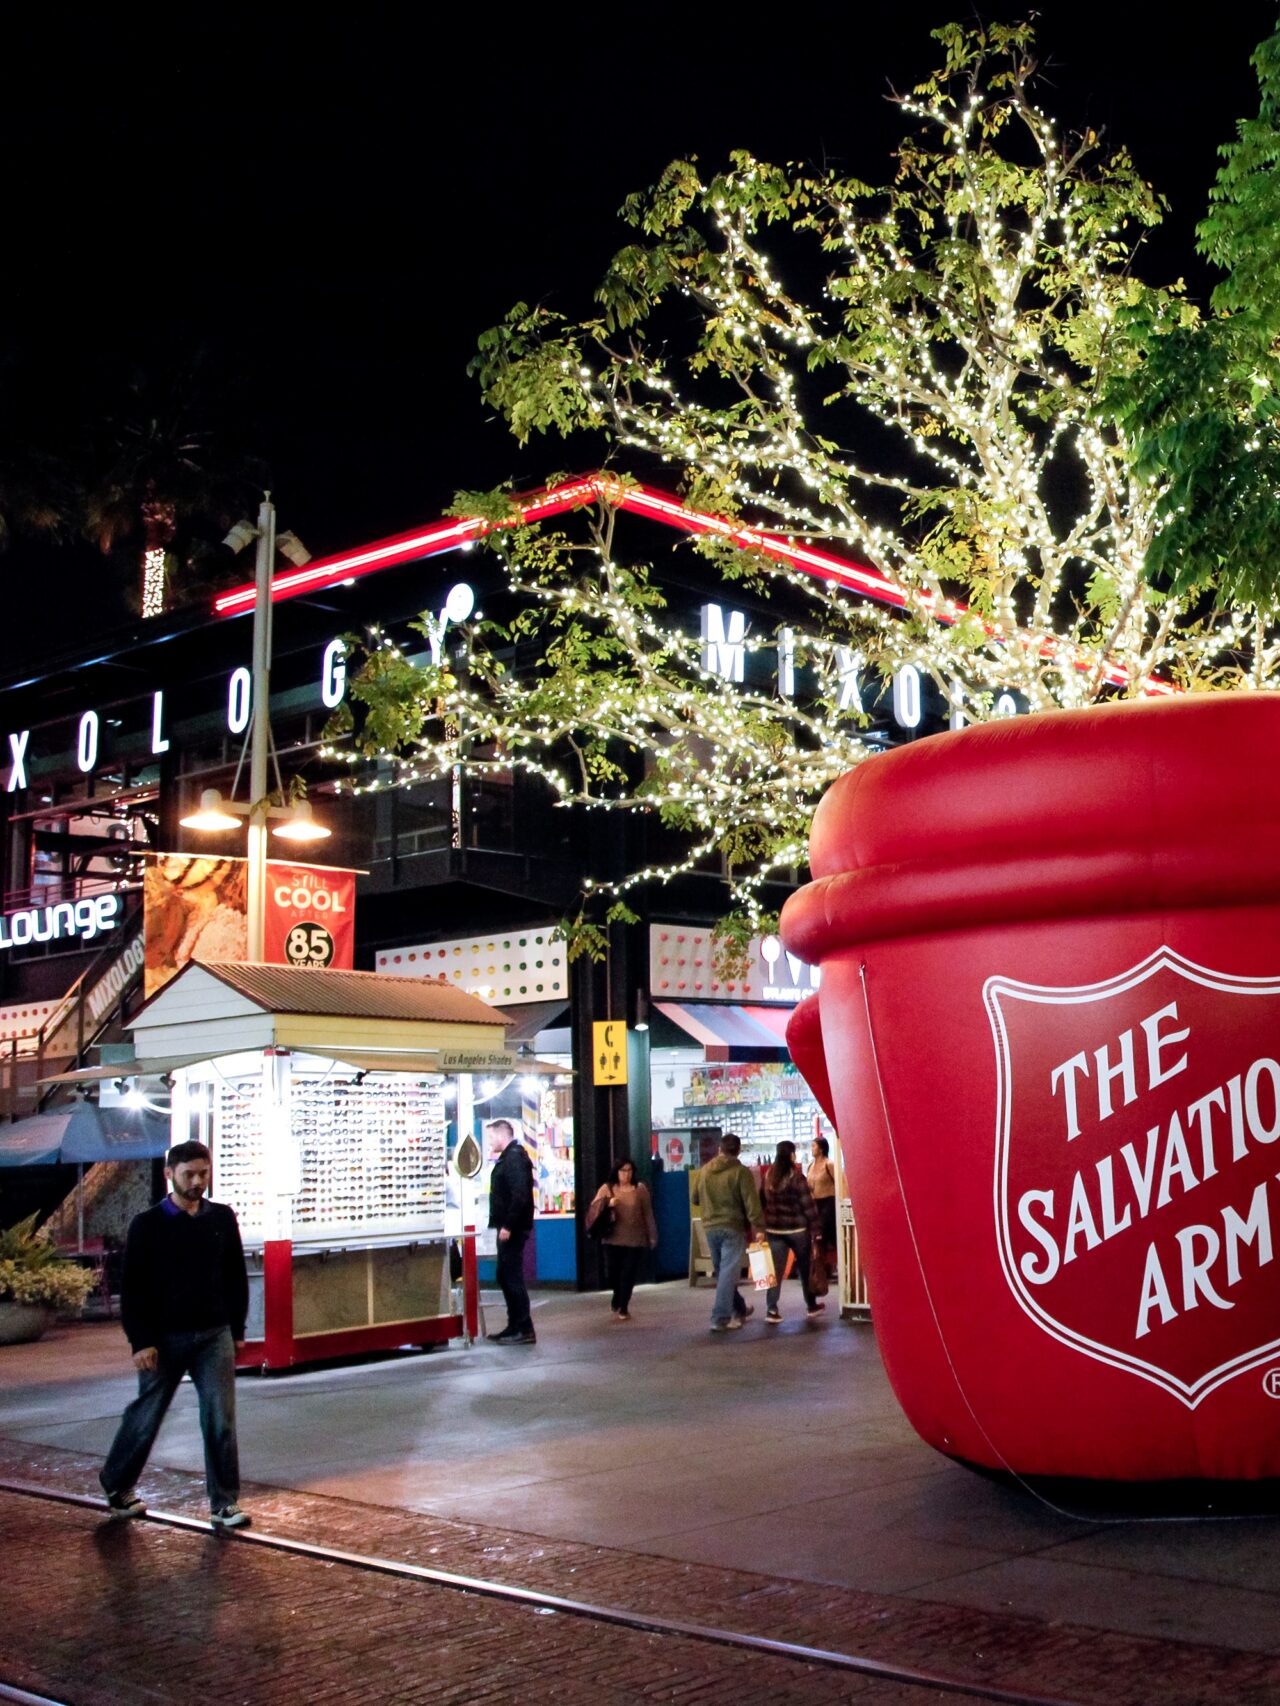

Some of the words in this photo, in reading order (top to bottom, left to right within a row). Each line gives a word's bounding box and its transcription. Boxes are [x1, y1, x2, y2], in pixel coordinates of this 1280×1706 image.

[274, 886, 346, 912] COOL
[288, 928, 330, 960] 85
[443, 1054, 457, 1065] Los
[458, 1053, 486, 1067] Angeles
[488, 1054, 512, 1066] Shades
[1051, 1001, 1191, 1142] THE
